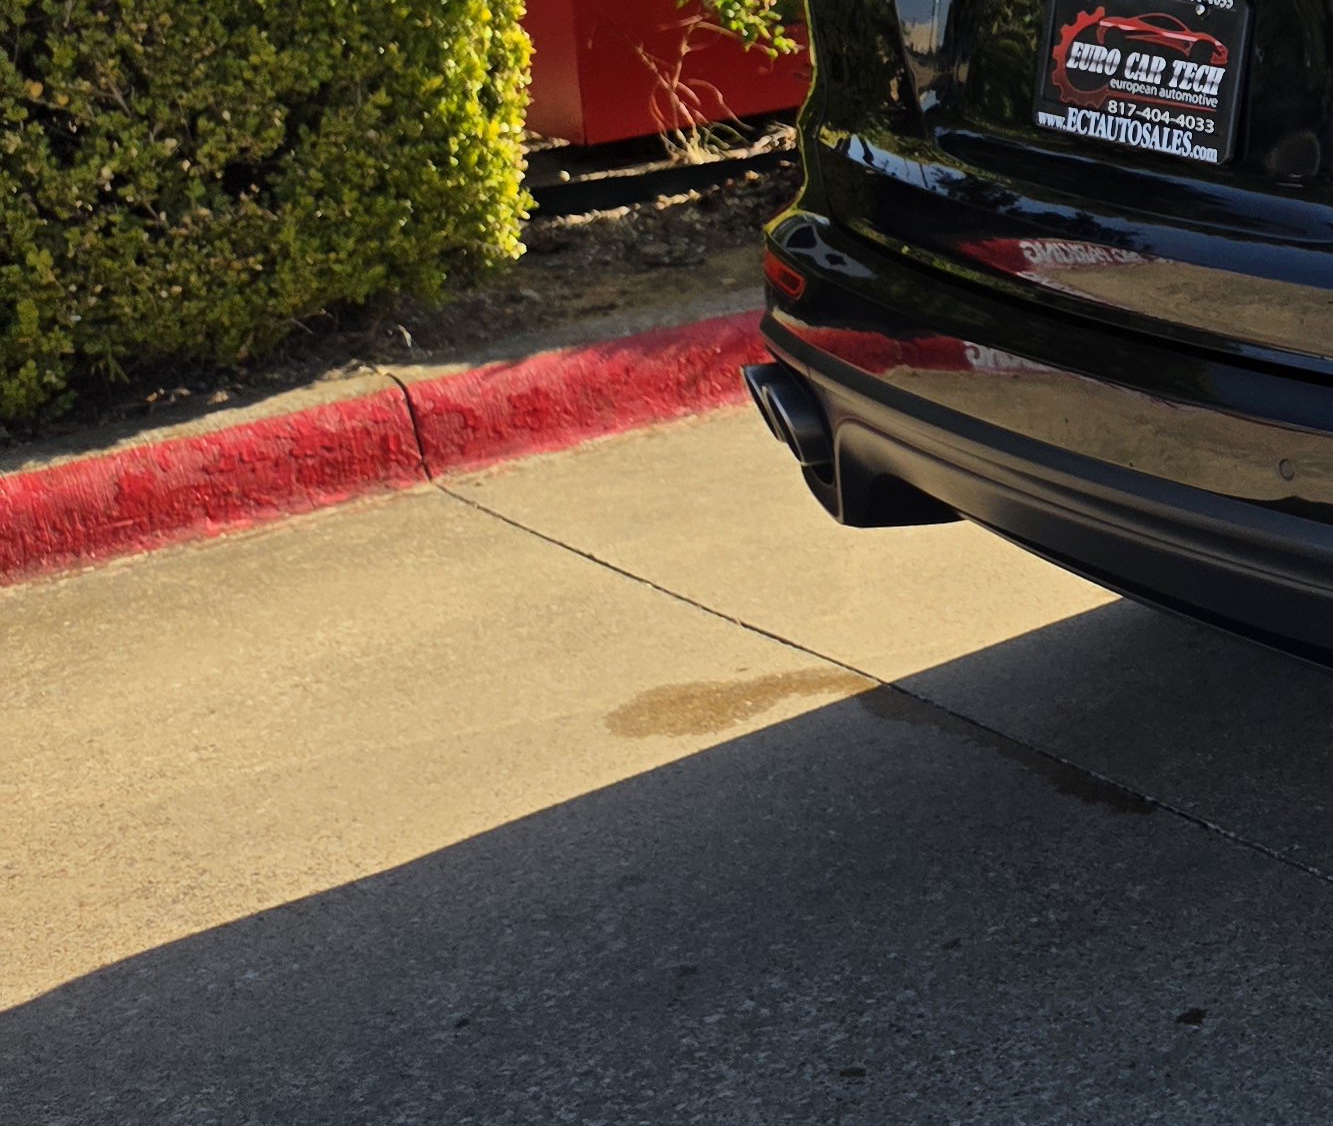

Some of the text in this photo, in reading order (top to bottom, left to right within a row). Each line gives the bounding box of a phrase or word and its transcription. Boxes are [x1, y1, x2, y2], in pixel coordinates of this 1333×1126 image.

[1066, 41, 1226, 96] EURO CAR TECH
[1109, 78, 1219, 108] european automotive
[1037, 107, 1218, 163] www.ECTAUTOSALES.com
[1107, 99, 1215, 134] 817-404-4033
